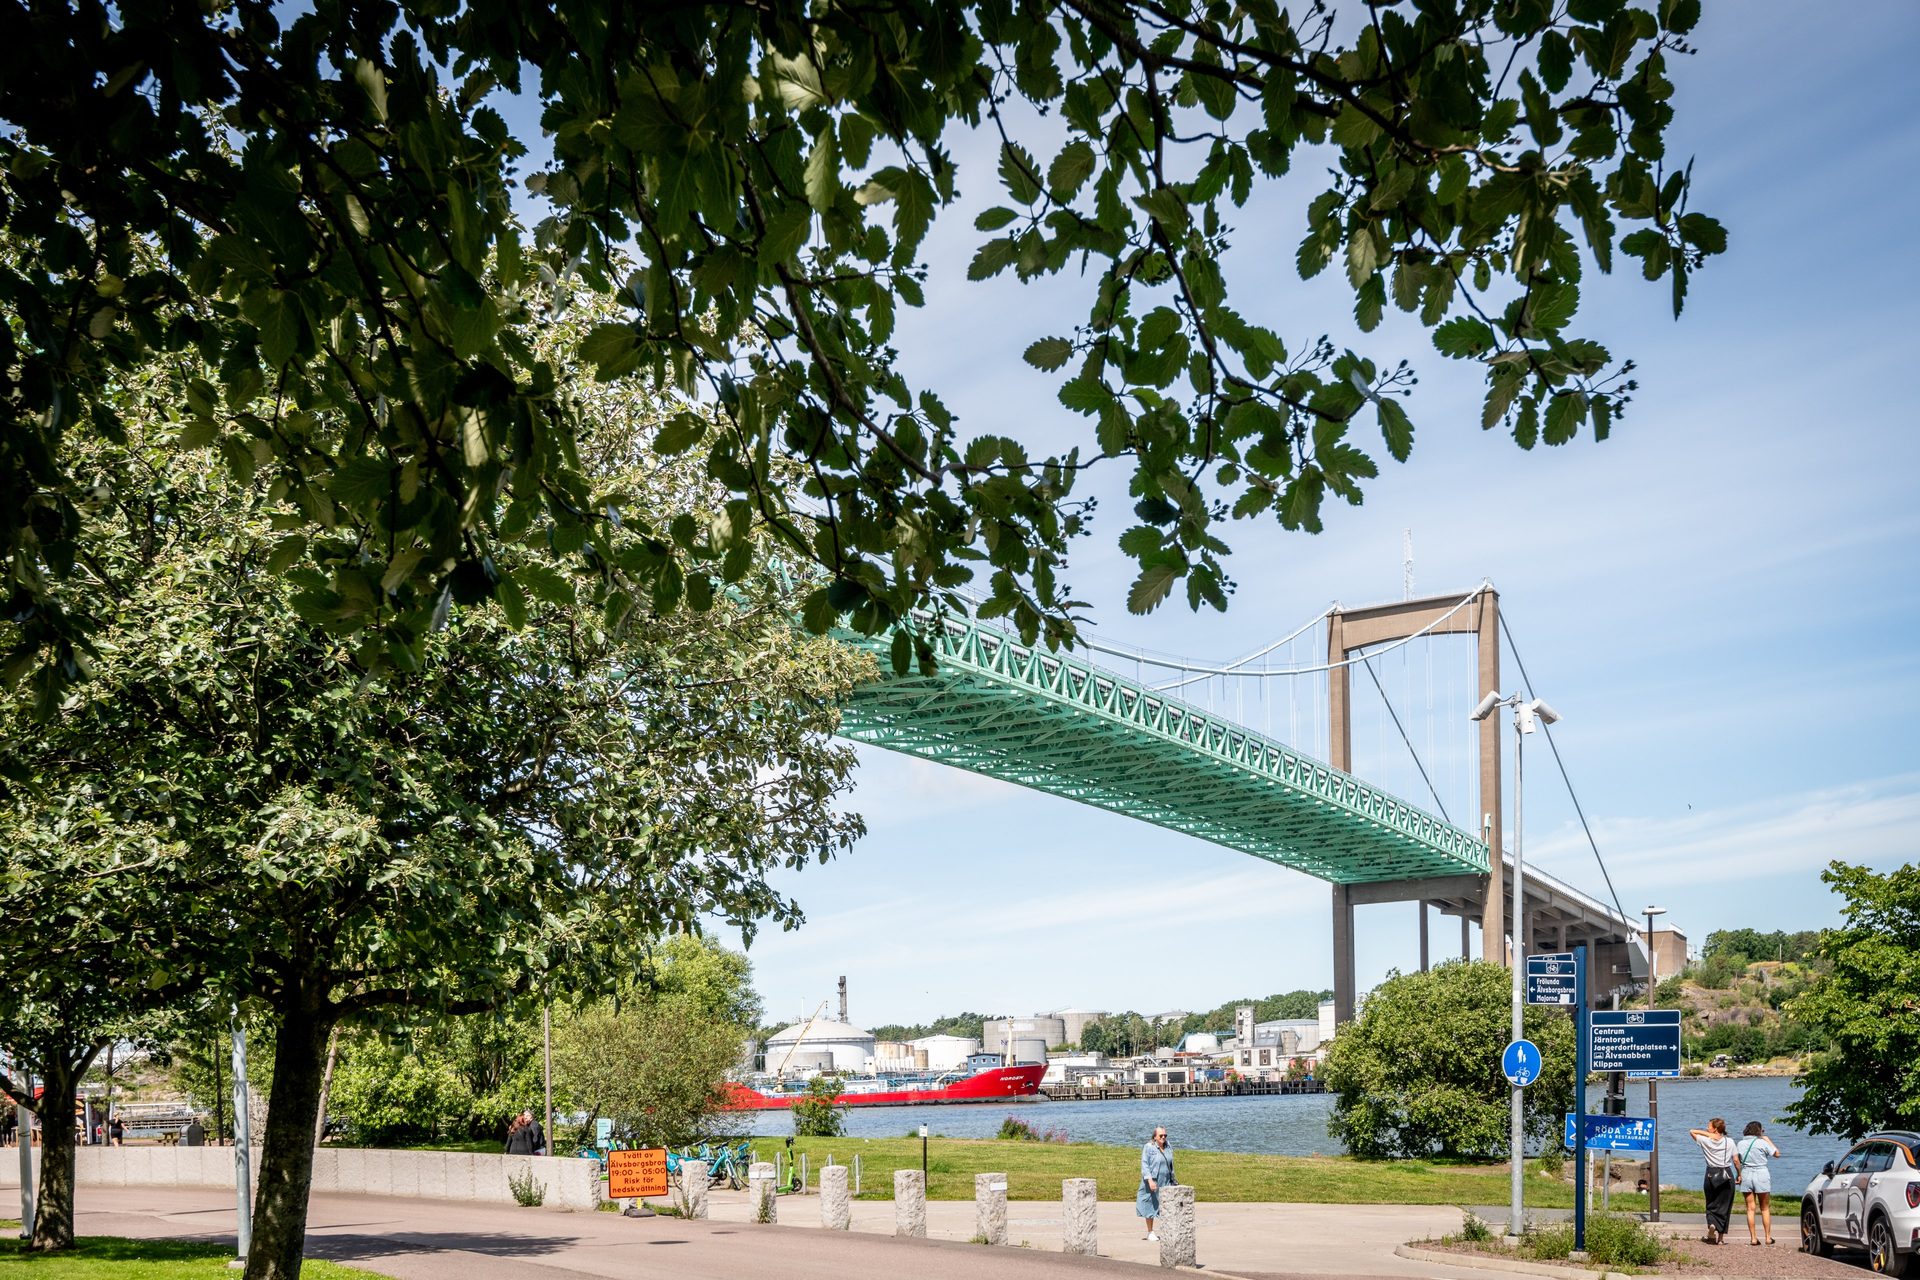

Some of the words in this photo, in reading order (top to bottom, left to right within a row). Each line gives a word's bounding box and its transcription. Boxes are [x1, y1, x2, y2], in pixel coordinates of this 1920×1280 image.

[1536, 977, 1560, 985] Frölunda
[1536, 985, 1575, 995] Älvsborgsbron
[1536, 995, 1558, 1003] Majorna
[1593, 1036, 1634, 1045] Järntorget
[1593, 1044, 1668, 1052] Jaegerdorffsplatsen
[1593, 1060, 1623, 1069] Klippan
[1595, 1125, 1621, 1134] RÖDA
[1626, 1127, 1650, 1136] STEN
[610, 1160, 666, 1168] Älvsborgsbron
[611, 1169, 633, 1177] 19:00
[642, 1167, 666, 1175] 05:00
[612, 1185, 666, 1193] nedskvättning
